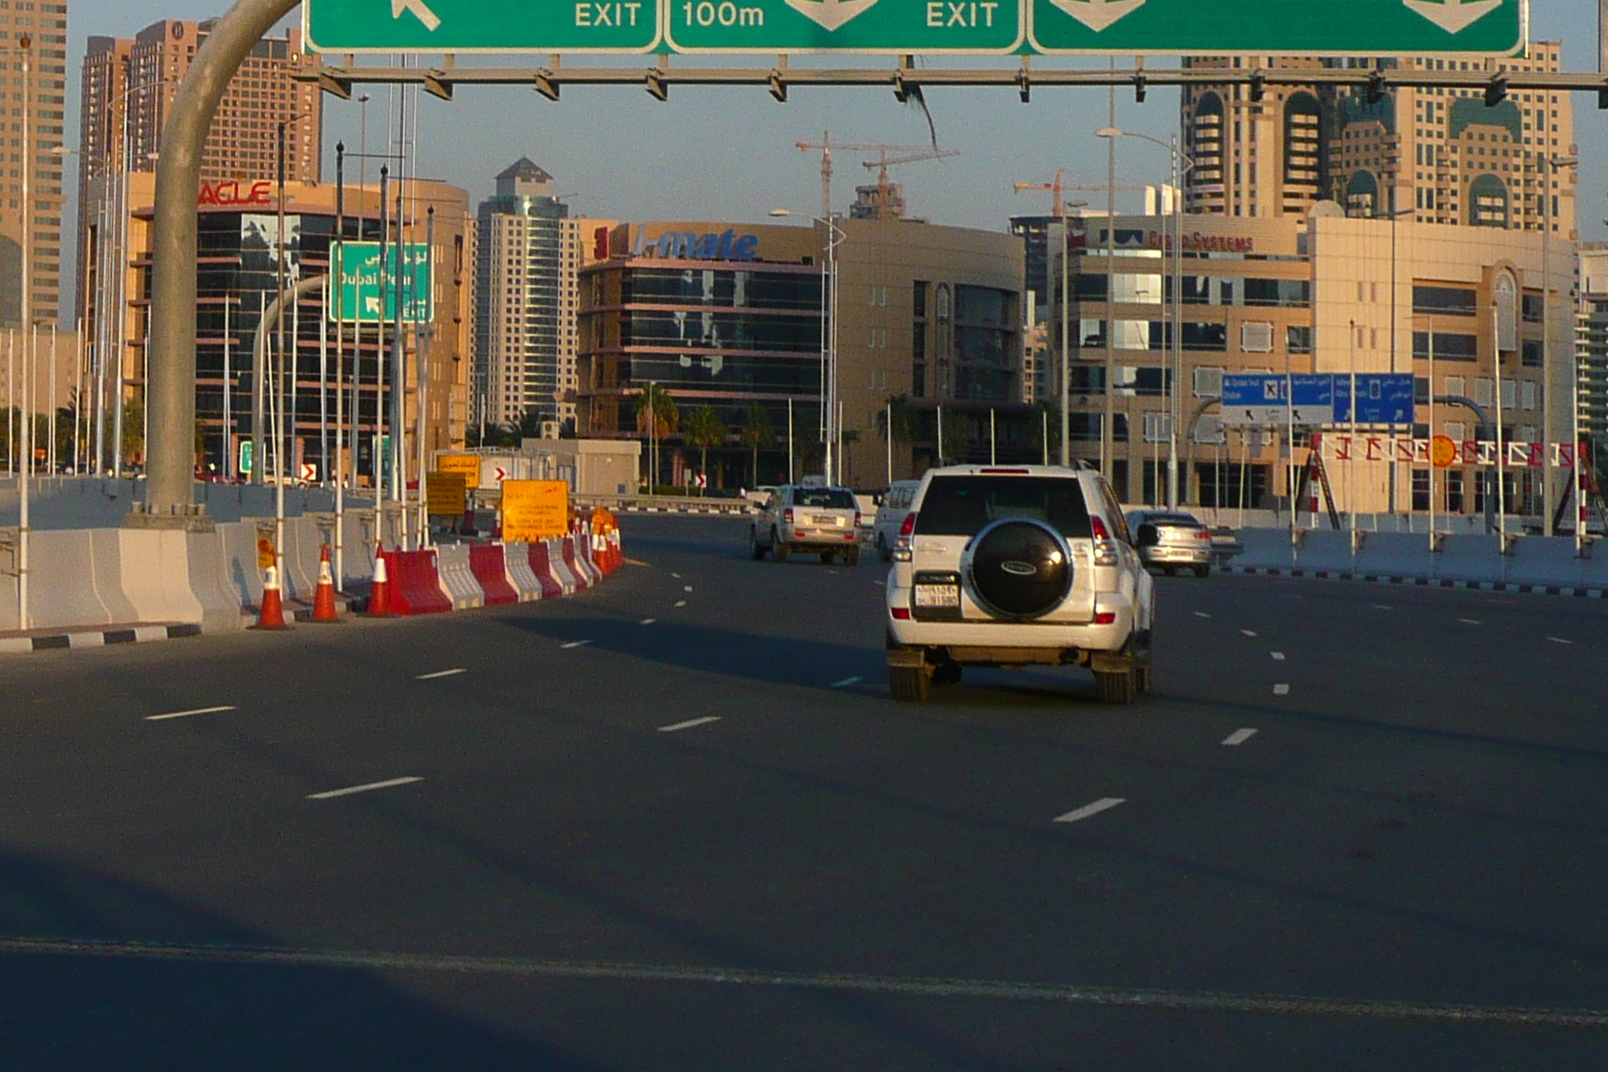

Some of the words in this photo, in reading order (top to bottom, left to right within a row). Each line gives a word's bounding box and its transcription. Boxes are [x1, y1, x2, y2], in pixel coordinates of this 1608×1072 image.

[575, 2, 642, 27] EXIT
[682, 1, 764, 27] 100m
[926, 1, 999, 27] EXIT
[197, 180, 272, 206] ACLE
